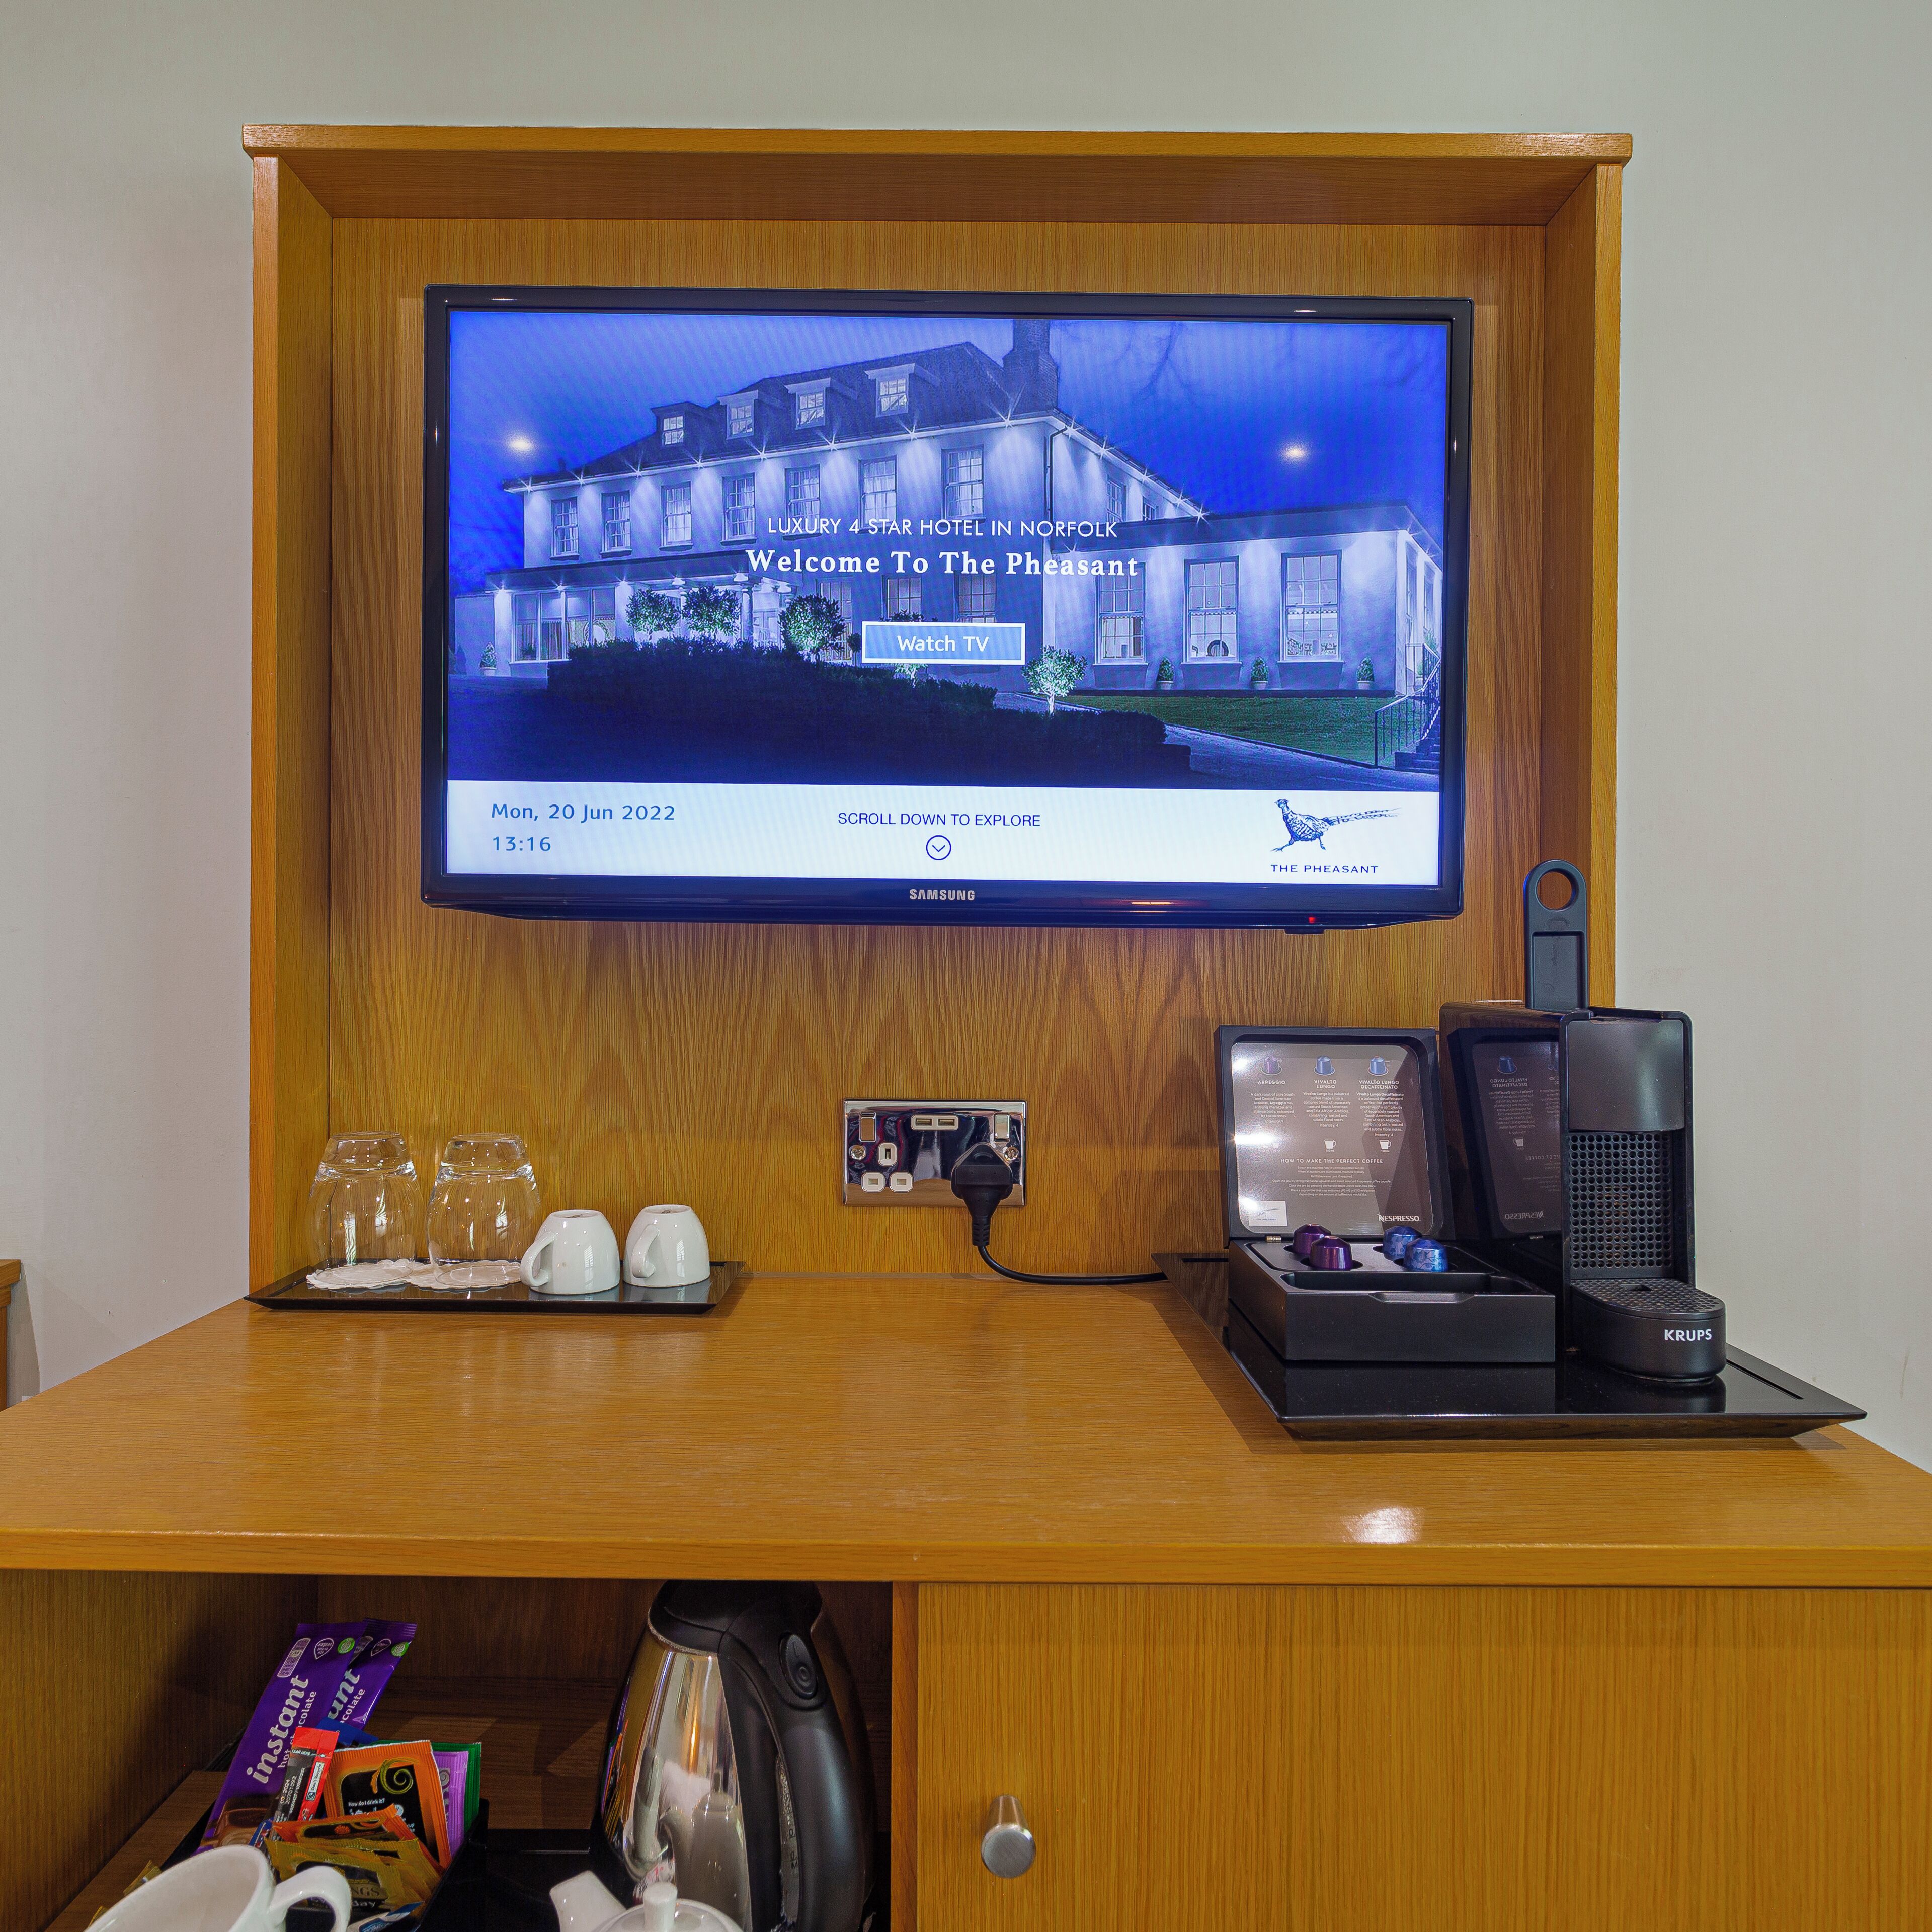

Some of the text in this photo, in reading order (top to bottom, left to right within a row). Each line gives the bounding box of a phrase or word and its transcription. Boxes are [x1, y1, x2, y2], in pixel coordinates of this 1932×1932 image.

[768, 517, 1117, 538] LUXURY 4 STAR HOTEL IN NORFOLK
[746, 549, 1138, 576] Welcome To The Pheasant
[897, 634, 989, 652] Watch TV
[492, 803, 675, 823] Mon, 20 Jun 2022
[838, 813, 1040, 826] SCROLL DOWN TO EXPLORE
[493, 836, 551, 851] 13:16
[1271, 864, 1379, 873] THE PHEASANT
[910, 889, 975, 901] SAMSUNG
[1378, 1214, 1420, 1222] NESPRESSO
[1664, 1329, 1712, 1341] KRUPS
[247, 1675, 308, 1784] instant
[278, 1748, 291, 1768] hot
